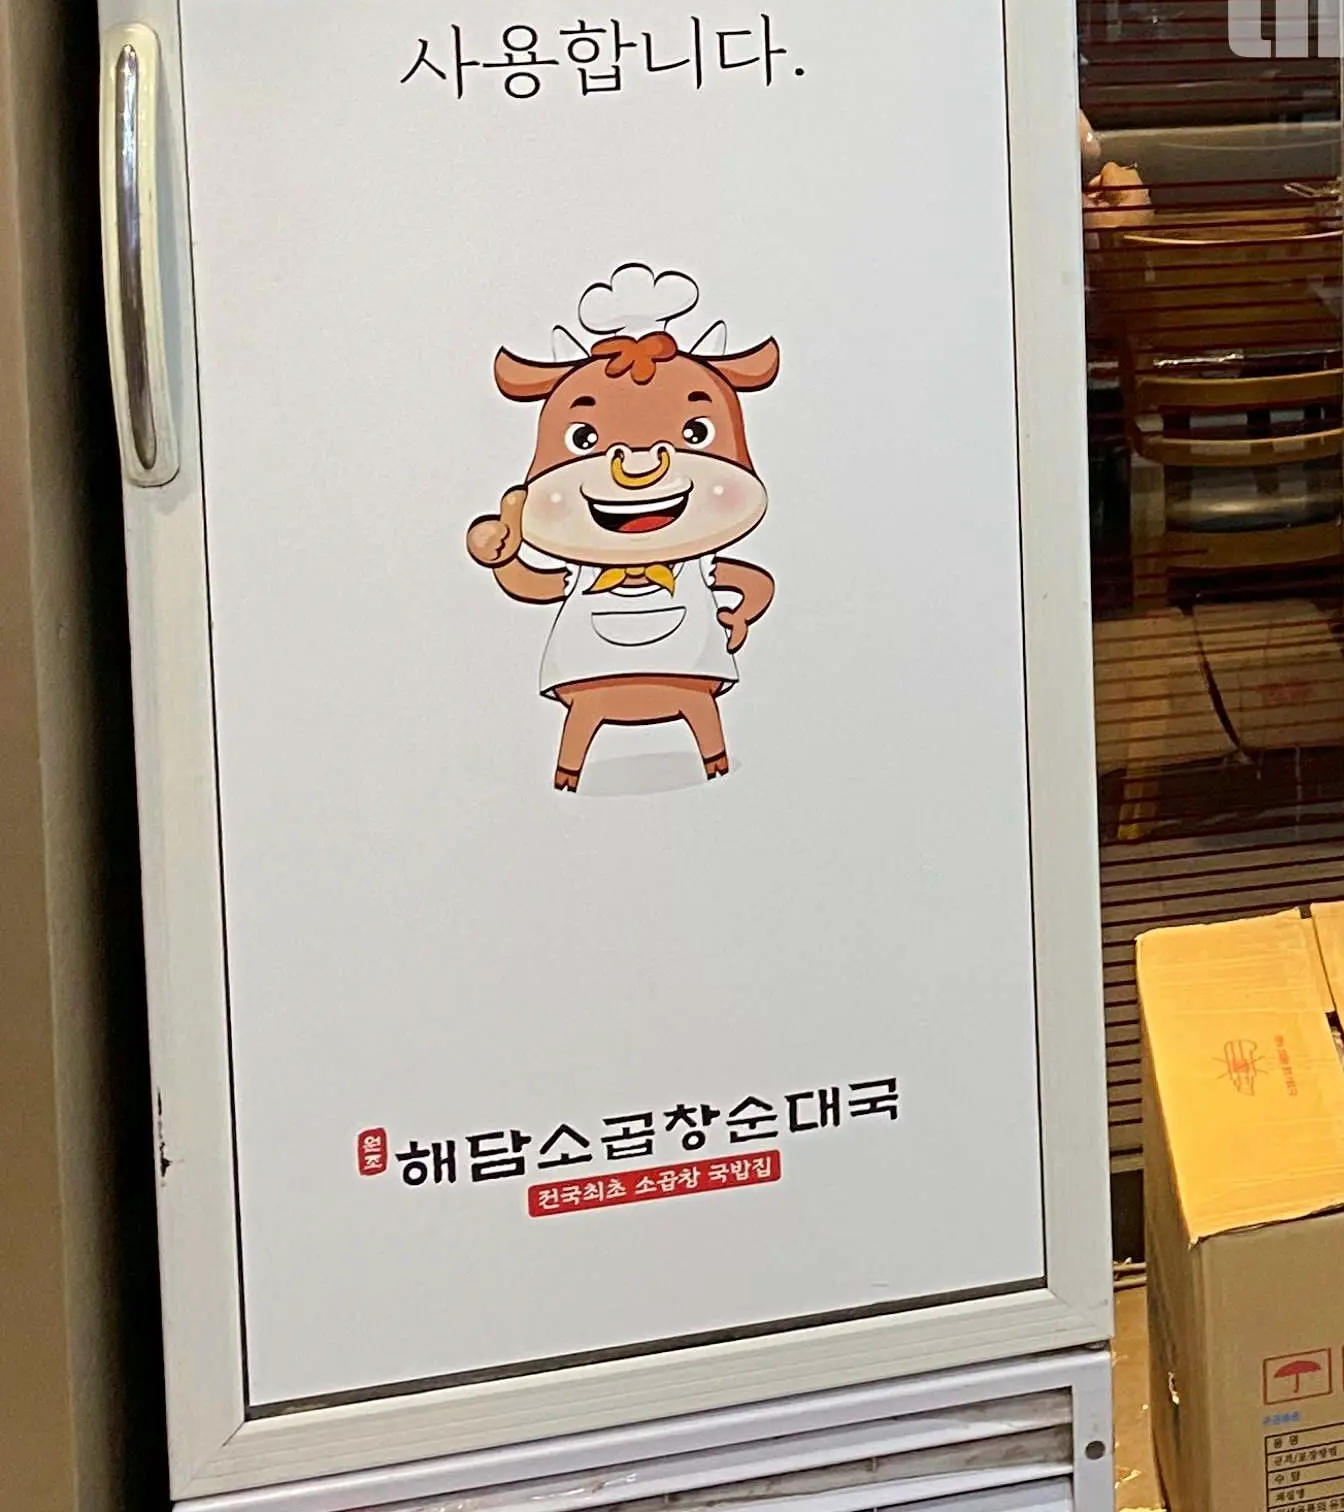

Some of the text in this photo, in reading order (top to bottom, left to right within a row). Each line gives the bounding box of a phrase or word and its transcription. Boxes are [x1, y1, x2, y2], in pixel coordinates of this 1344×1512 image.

[400, 12, 806, 100] 사용합니다.
[394, 1077, 900, 1187] 해담소곱창순대국
[537, 1155, 774, 1209] 전국최초 소곱창 국밥집
